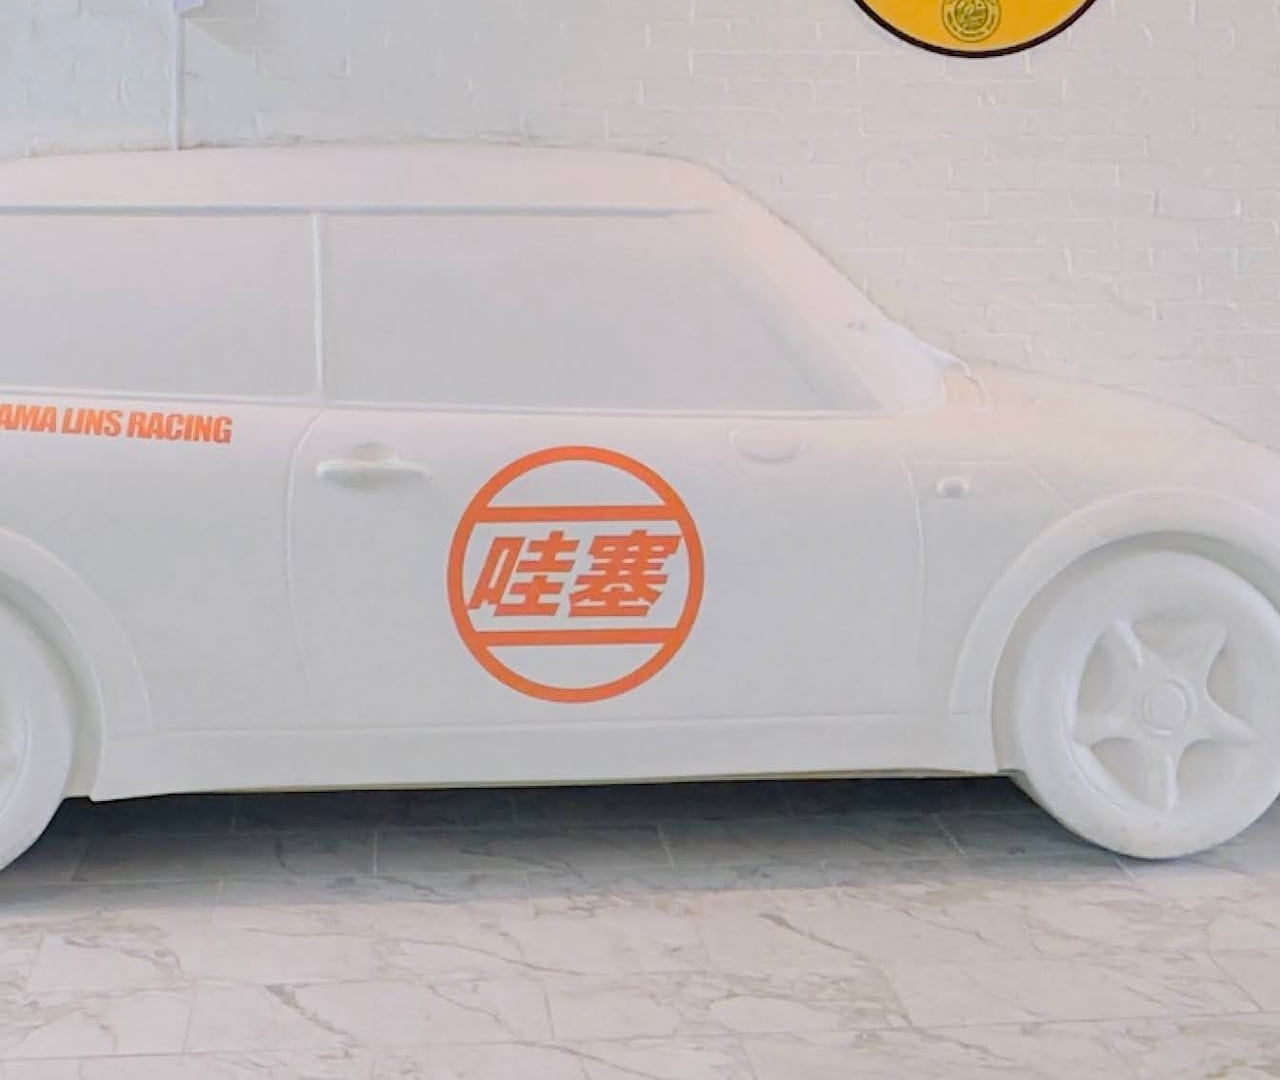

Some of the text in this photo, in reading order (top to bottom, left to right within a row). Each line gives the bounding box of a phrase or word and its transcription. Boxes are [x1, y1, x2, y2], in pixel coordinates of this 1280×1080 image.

[61, 407, 122, 437] LINS
[127, 410, 233, 444] RACING
[466, 528, 681, 618] 哇塞
